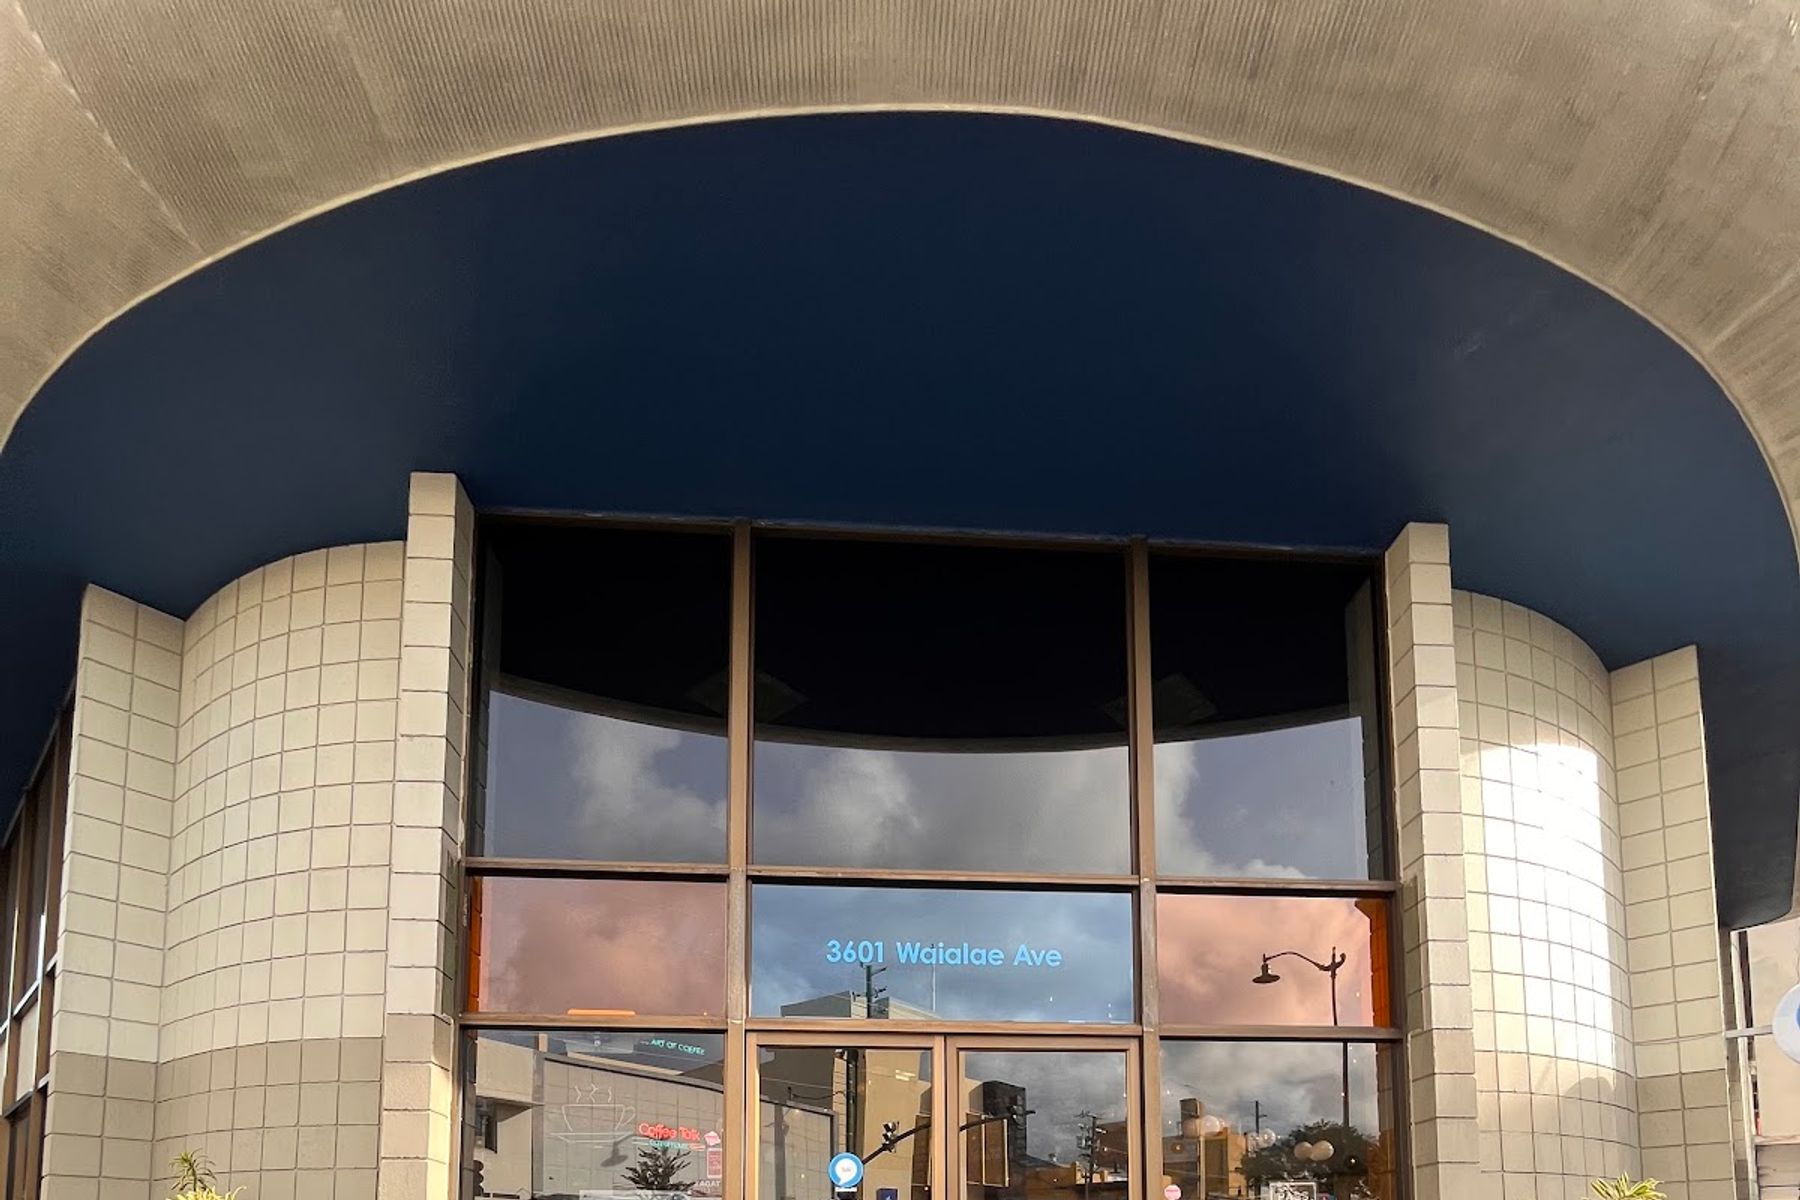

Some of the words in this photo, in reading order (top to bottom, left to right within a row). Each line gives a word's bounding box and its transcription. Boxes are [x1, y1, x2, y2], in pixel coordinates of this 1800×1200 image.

[826, 940, 884, 963] 3601
[896, 942, 1004, 966] Waialae
[1013, 944, 1062, 966] Ave
[639, 1123, 677, 1139] Coffee
